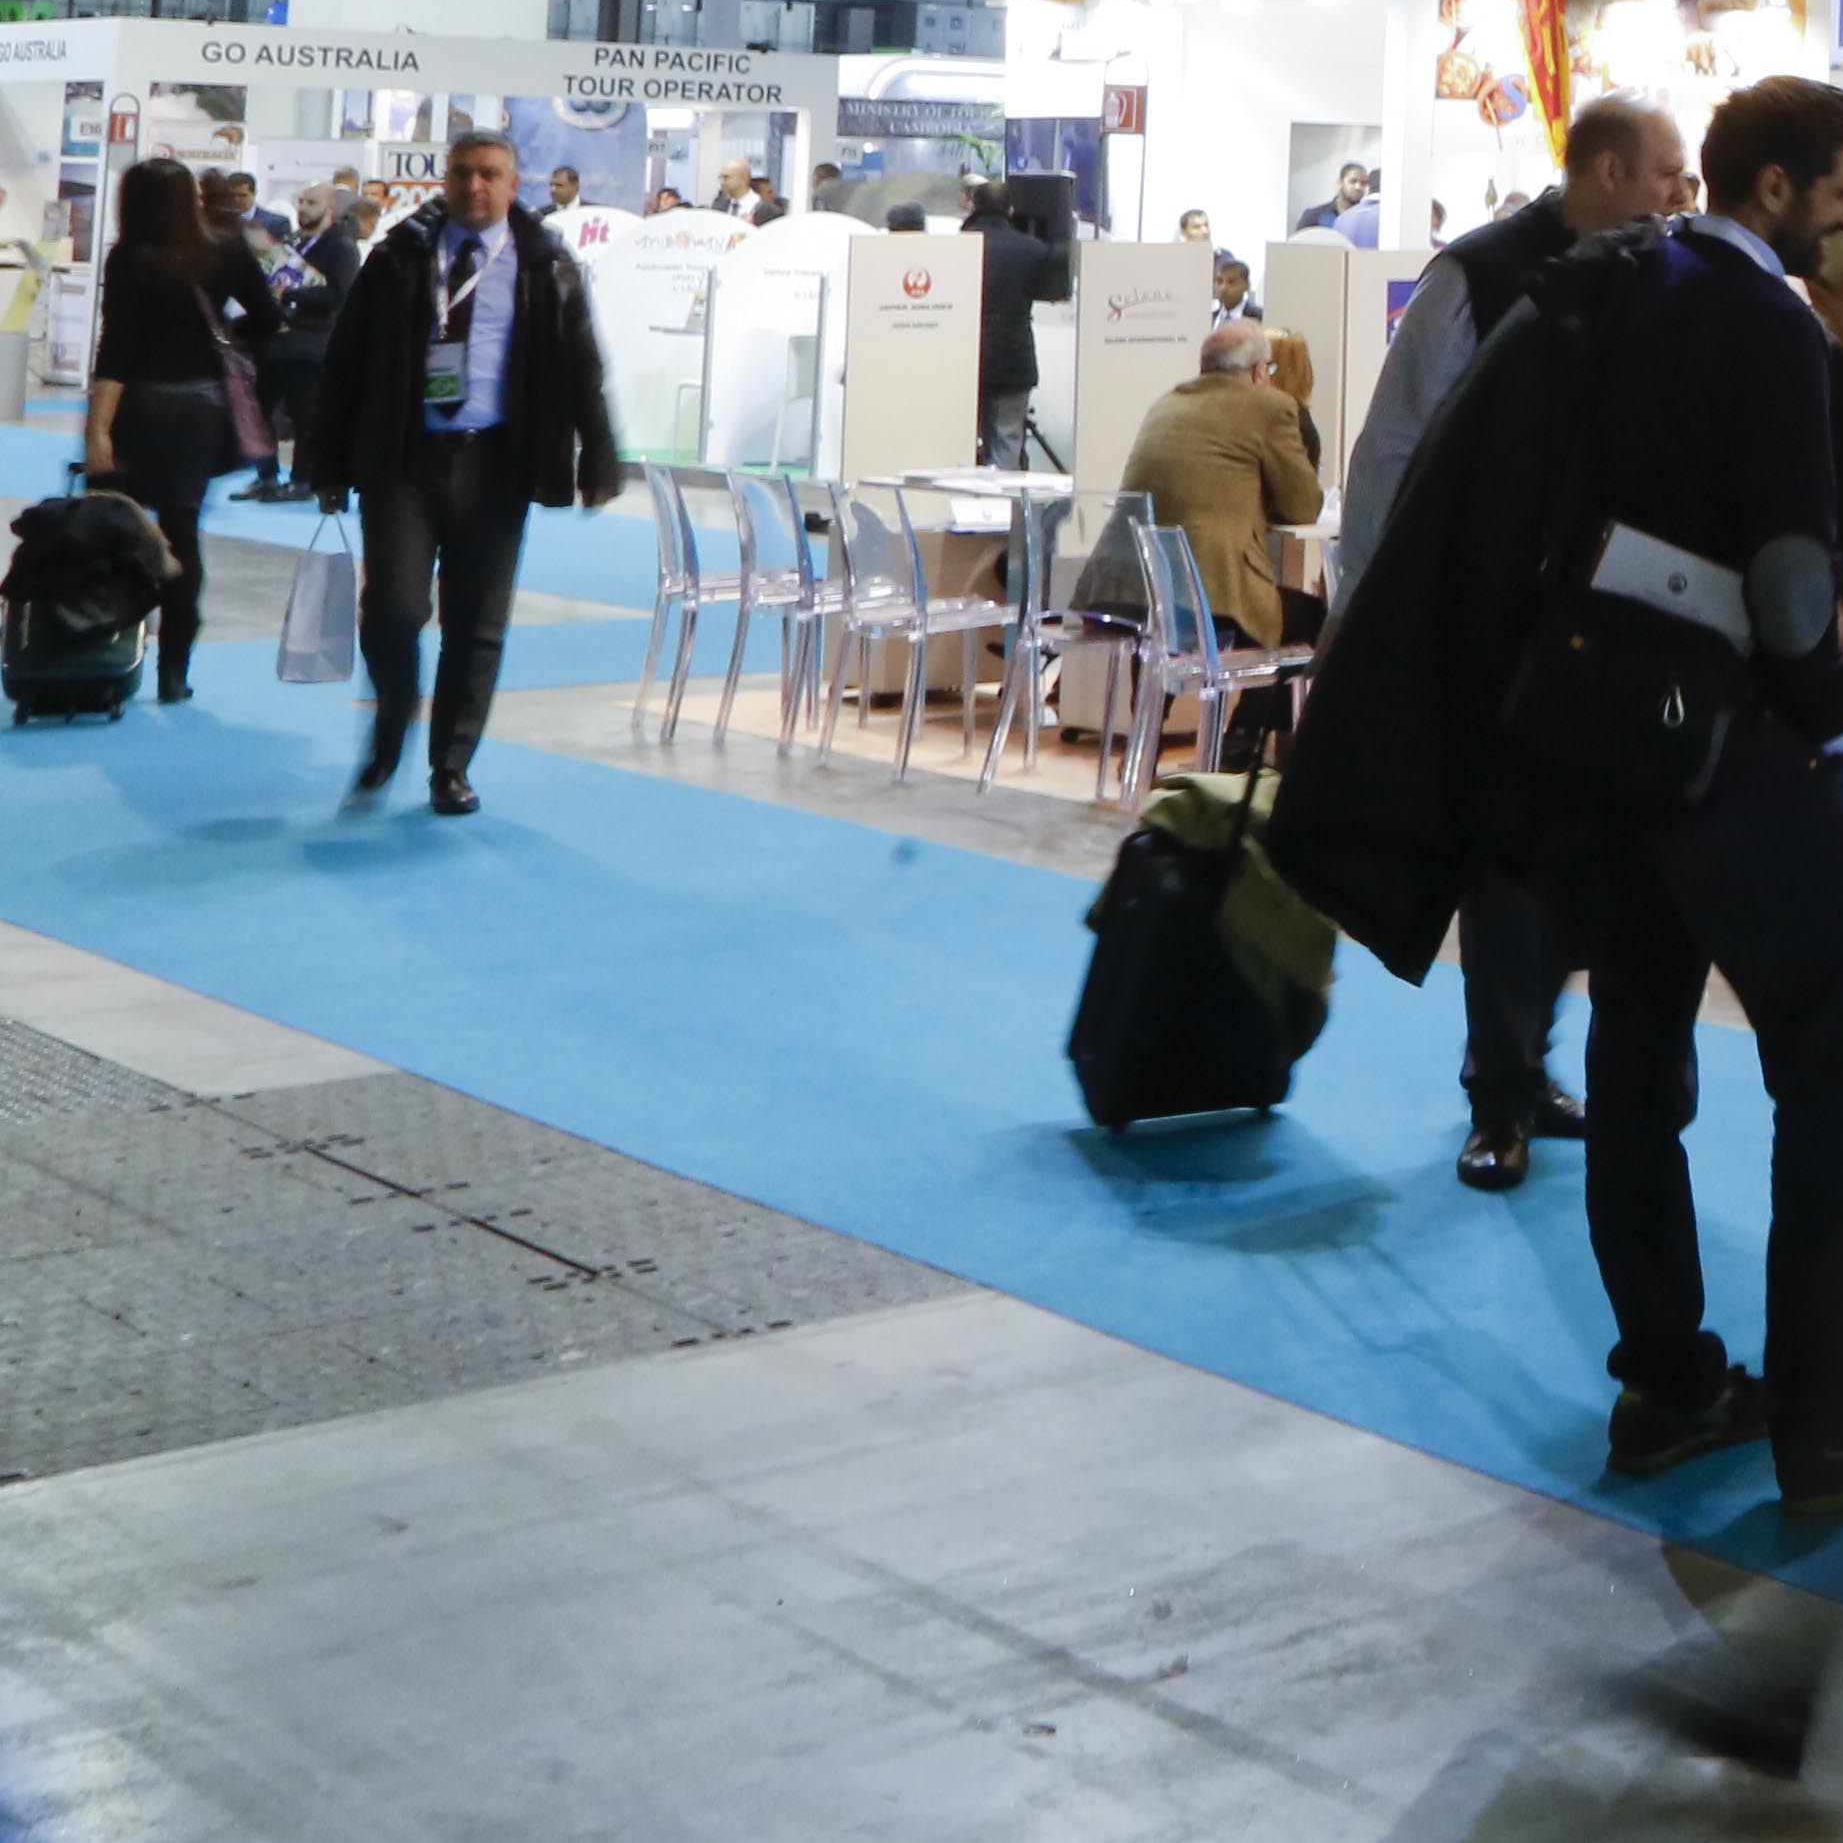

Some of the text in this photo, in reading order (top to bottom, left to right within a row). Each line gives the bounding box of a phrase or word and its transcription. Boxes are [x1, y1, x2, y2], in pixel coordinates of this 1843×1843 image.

[13, 39, 67, 62] AUSTRALIA
[201, 41, 420, 73] GO AUSTRALIA
[593, 47, 752, 75] PAN PACIFIC
[563, 74, 783, 104] TOUR OPERATOR
